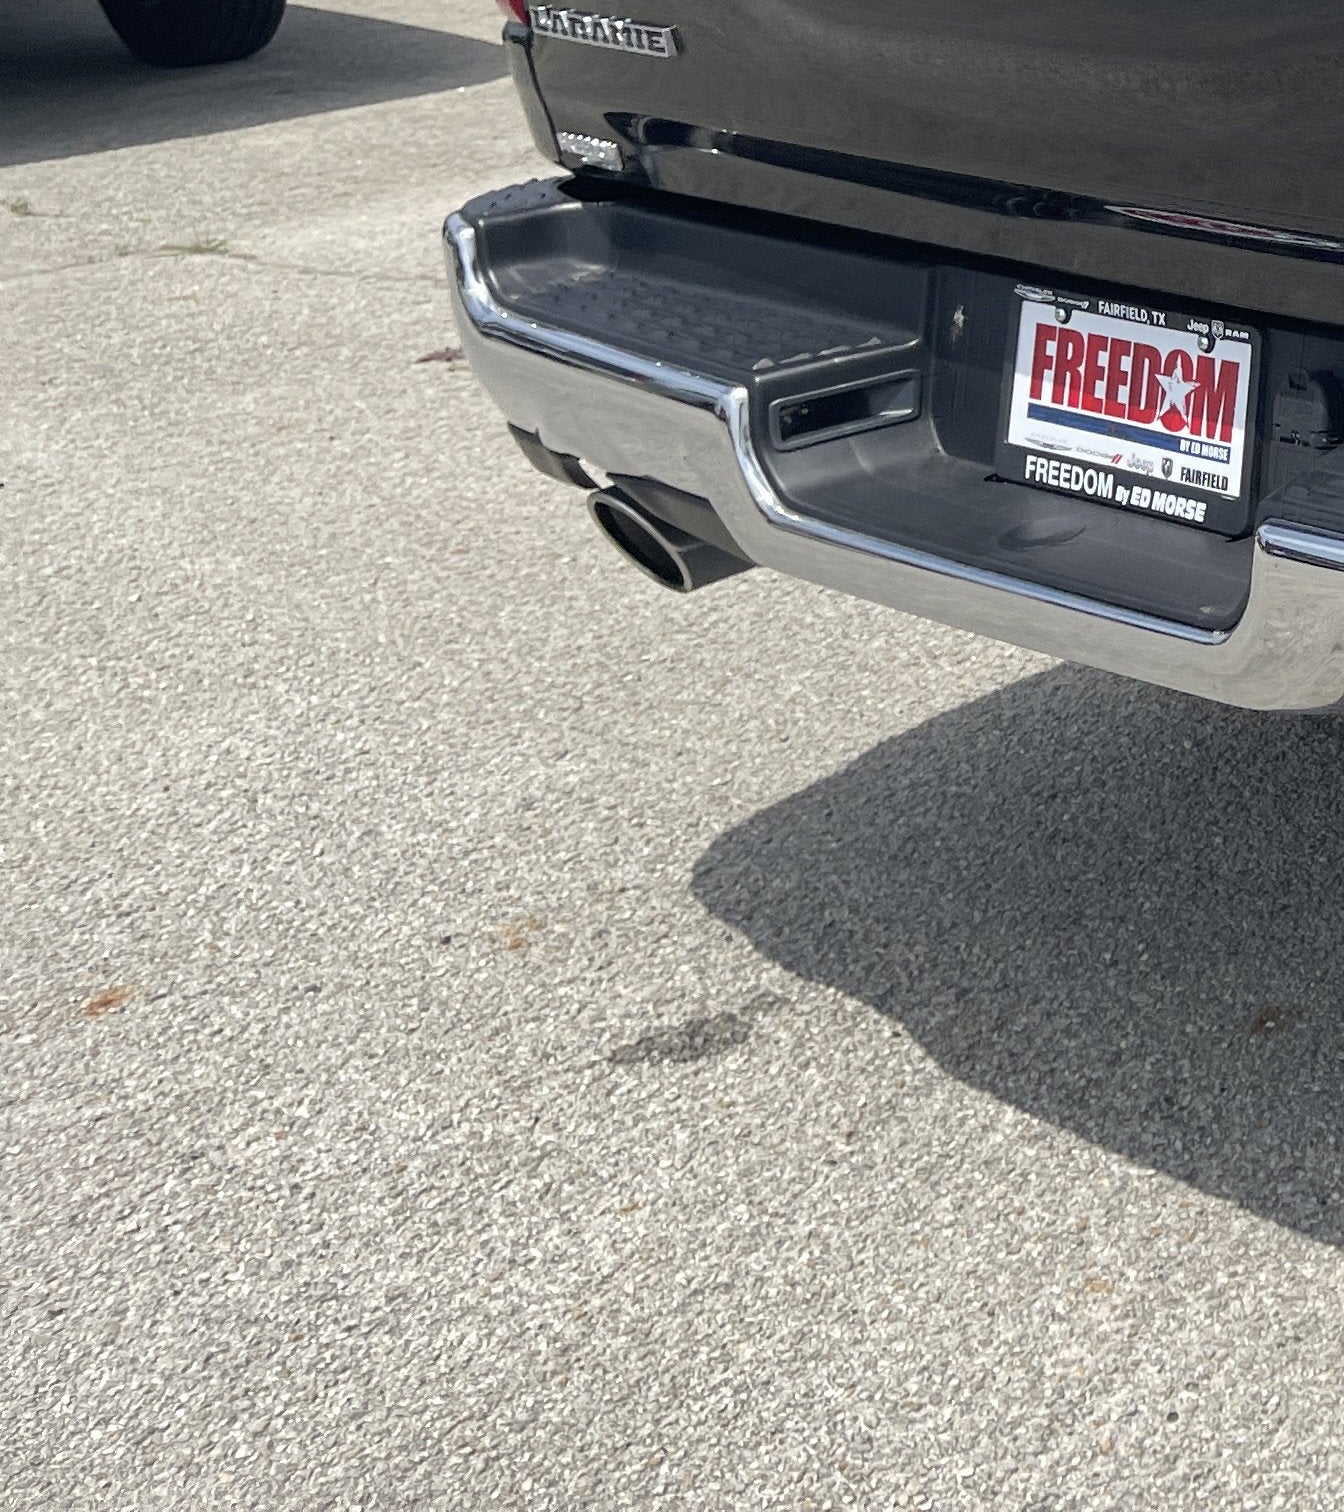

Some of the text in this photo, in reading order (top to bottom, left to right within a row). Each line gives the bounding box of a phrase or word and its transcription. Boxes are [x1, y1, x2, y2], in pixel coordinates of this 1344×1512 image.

[530, 4, 678, 58] LARAMIE
[1151, 311, 1167, 326] TX
[1029, 322, 1240, 443] FREEDOM
[1179, 438, 1229, 461] BY ED MORSE
[1025, 455, 1114, 499] FREEDOM
[1130, 486, 1150, 509] ED
[1152, 491, 1208, 523] MORSE
[1179, 466, 1229, 492] FAIRFIELD
